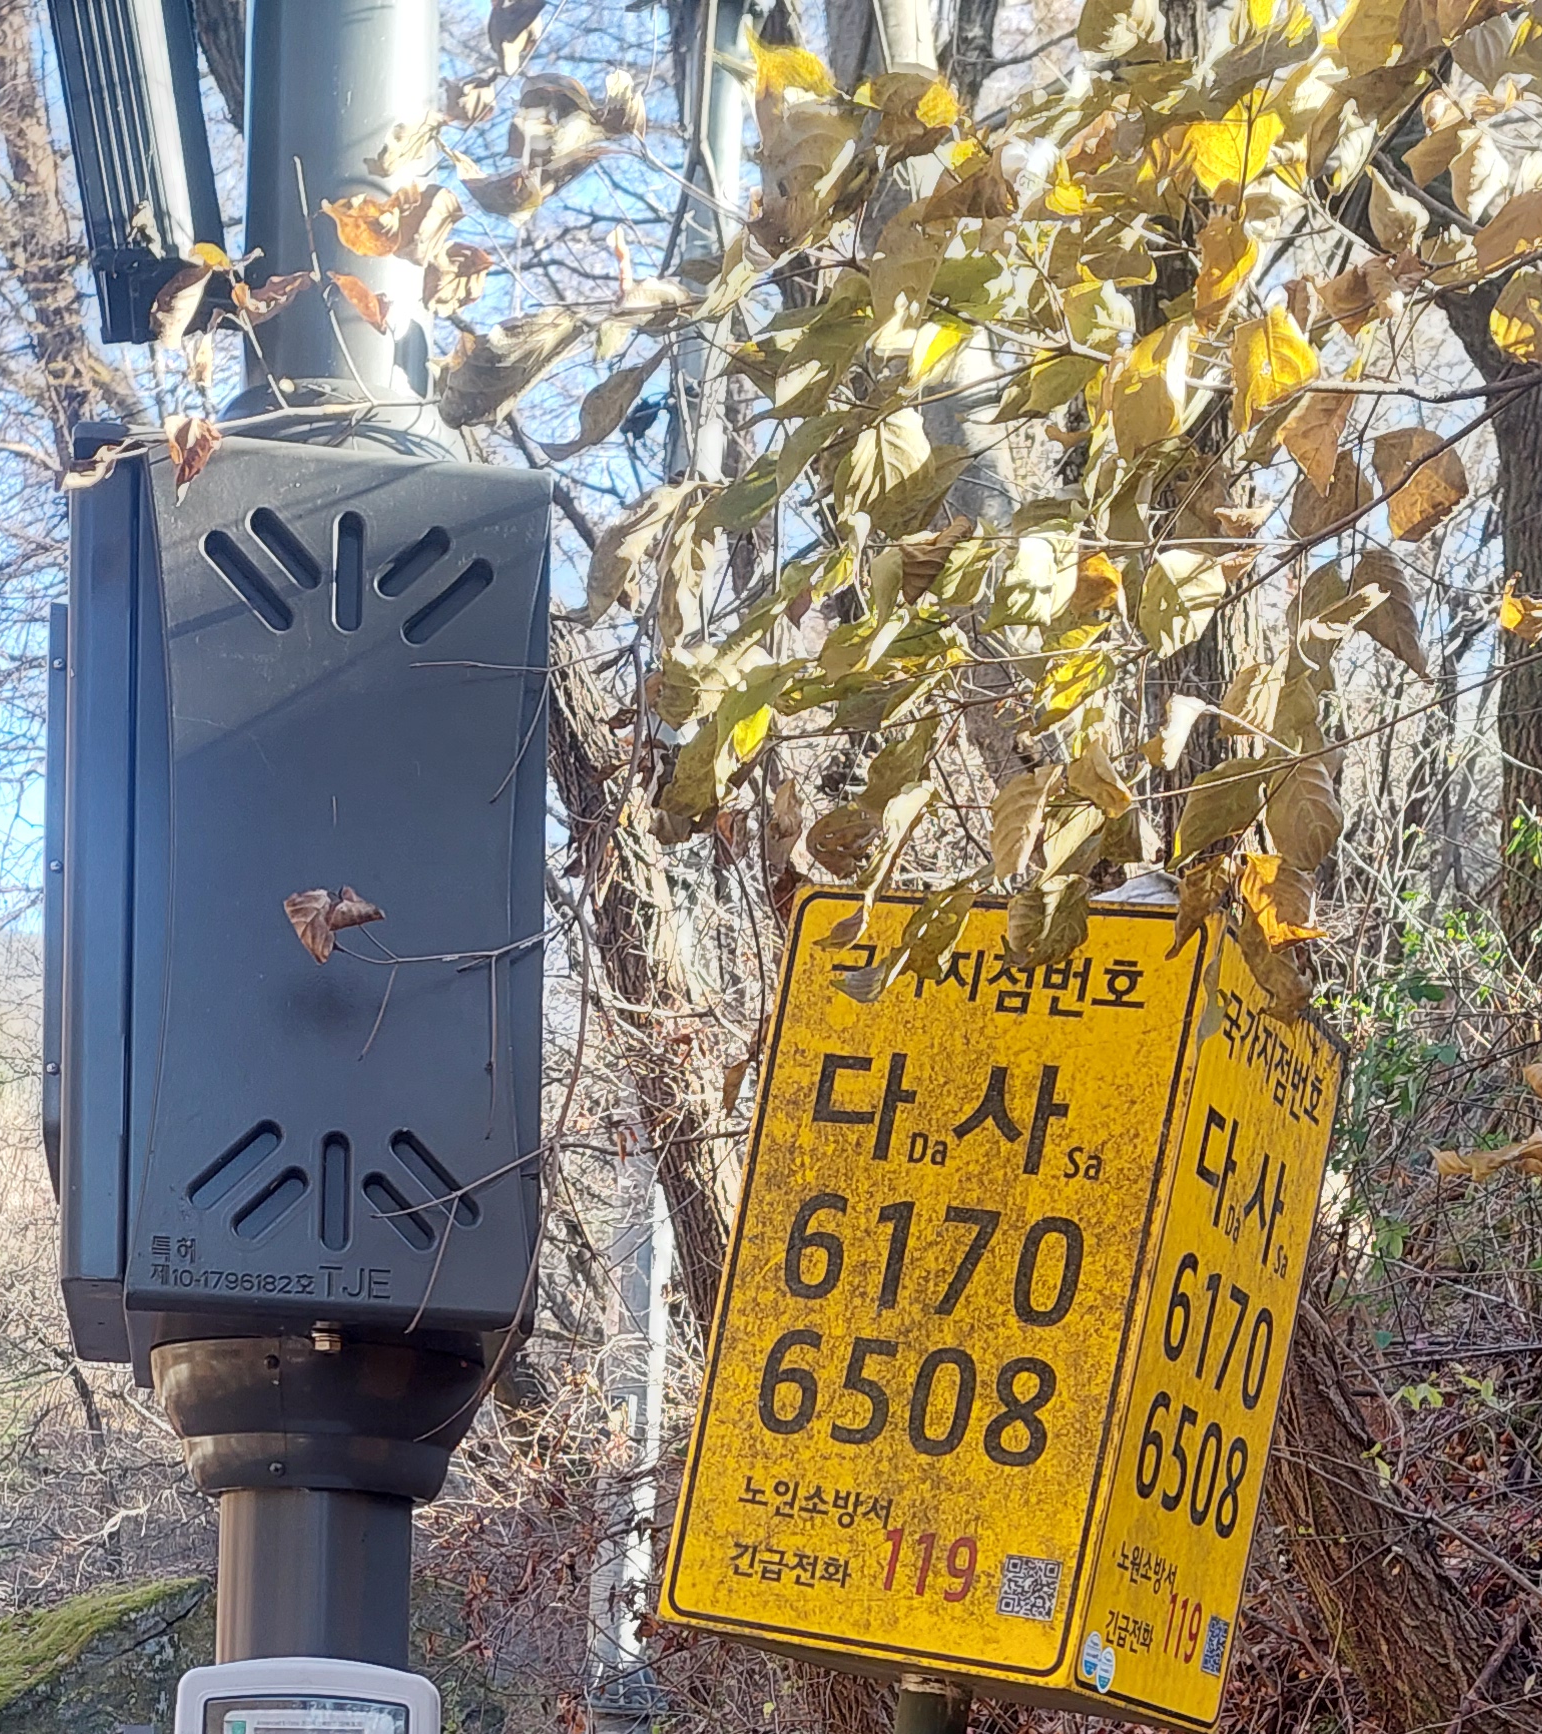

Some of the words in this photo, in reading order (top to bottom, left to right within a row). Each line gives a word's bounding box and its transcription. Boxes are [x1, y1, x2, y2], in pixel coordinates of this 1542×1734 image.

[907, 1131, 948, 1167] Da
[784, 1192, 1084, 1327] 6170
[1224, 1202, 1242, 1245] Da
[318, 1265, 392, 1300] TJE
[1163, 1252, 1274, 1411] 6170
[759, 1329, 1057, 1467] 6508
[1136, 1391, 1248, 1539] 6508
[728, 1541, 852, 1589] 긴급전화
[882, 1528, 978, 1603] 119
[1116, 1541, 1178, 1595] 노원소방서
[1105, 1609, 1154, 1654] 긴급전화
[1163, 1592, 1203, 1664] 119
